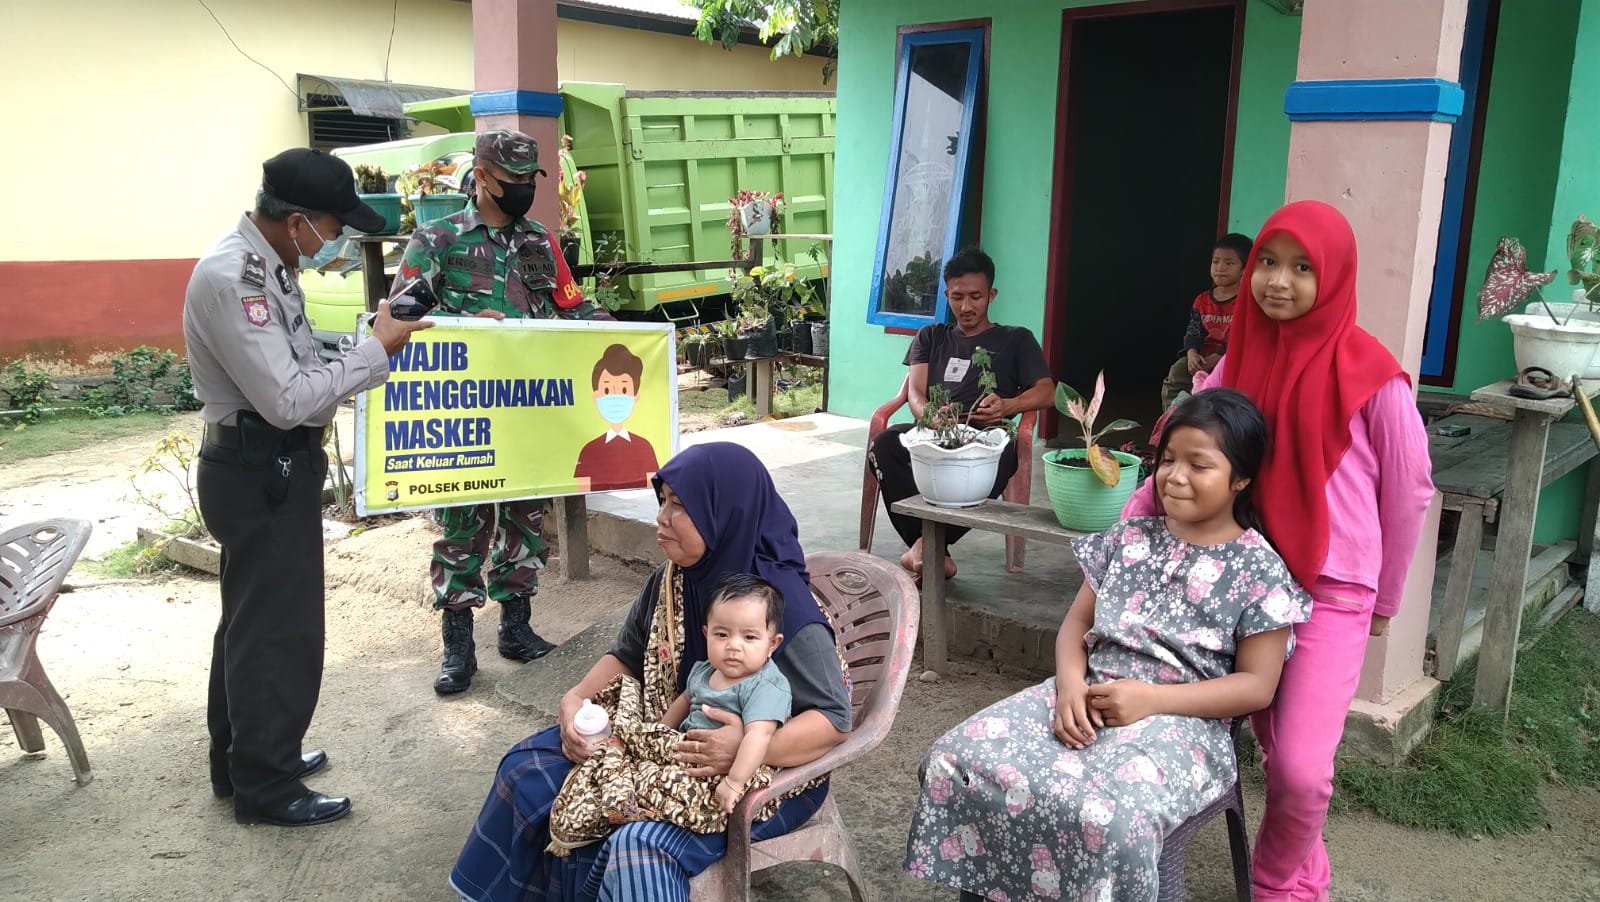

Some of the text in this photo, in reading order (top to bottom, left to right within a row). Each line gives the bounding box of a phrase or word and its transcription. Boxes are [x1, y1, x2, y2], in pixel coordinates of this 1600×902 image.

[389, 342, 468, 372] WAJIB
[385, 379, 575, 411] MENGGUNAKAN
[385, 418, 491, 450] MASKER
[387, 452, 493, 470] Saat Keluar Rumah
[409, 482, 460, 495] POLSEK
[463, 479, 506, 491] BUNUT
